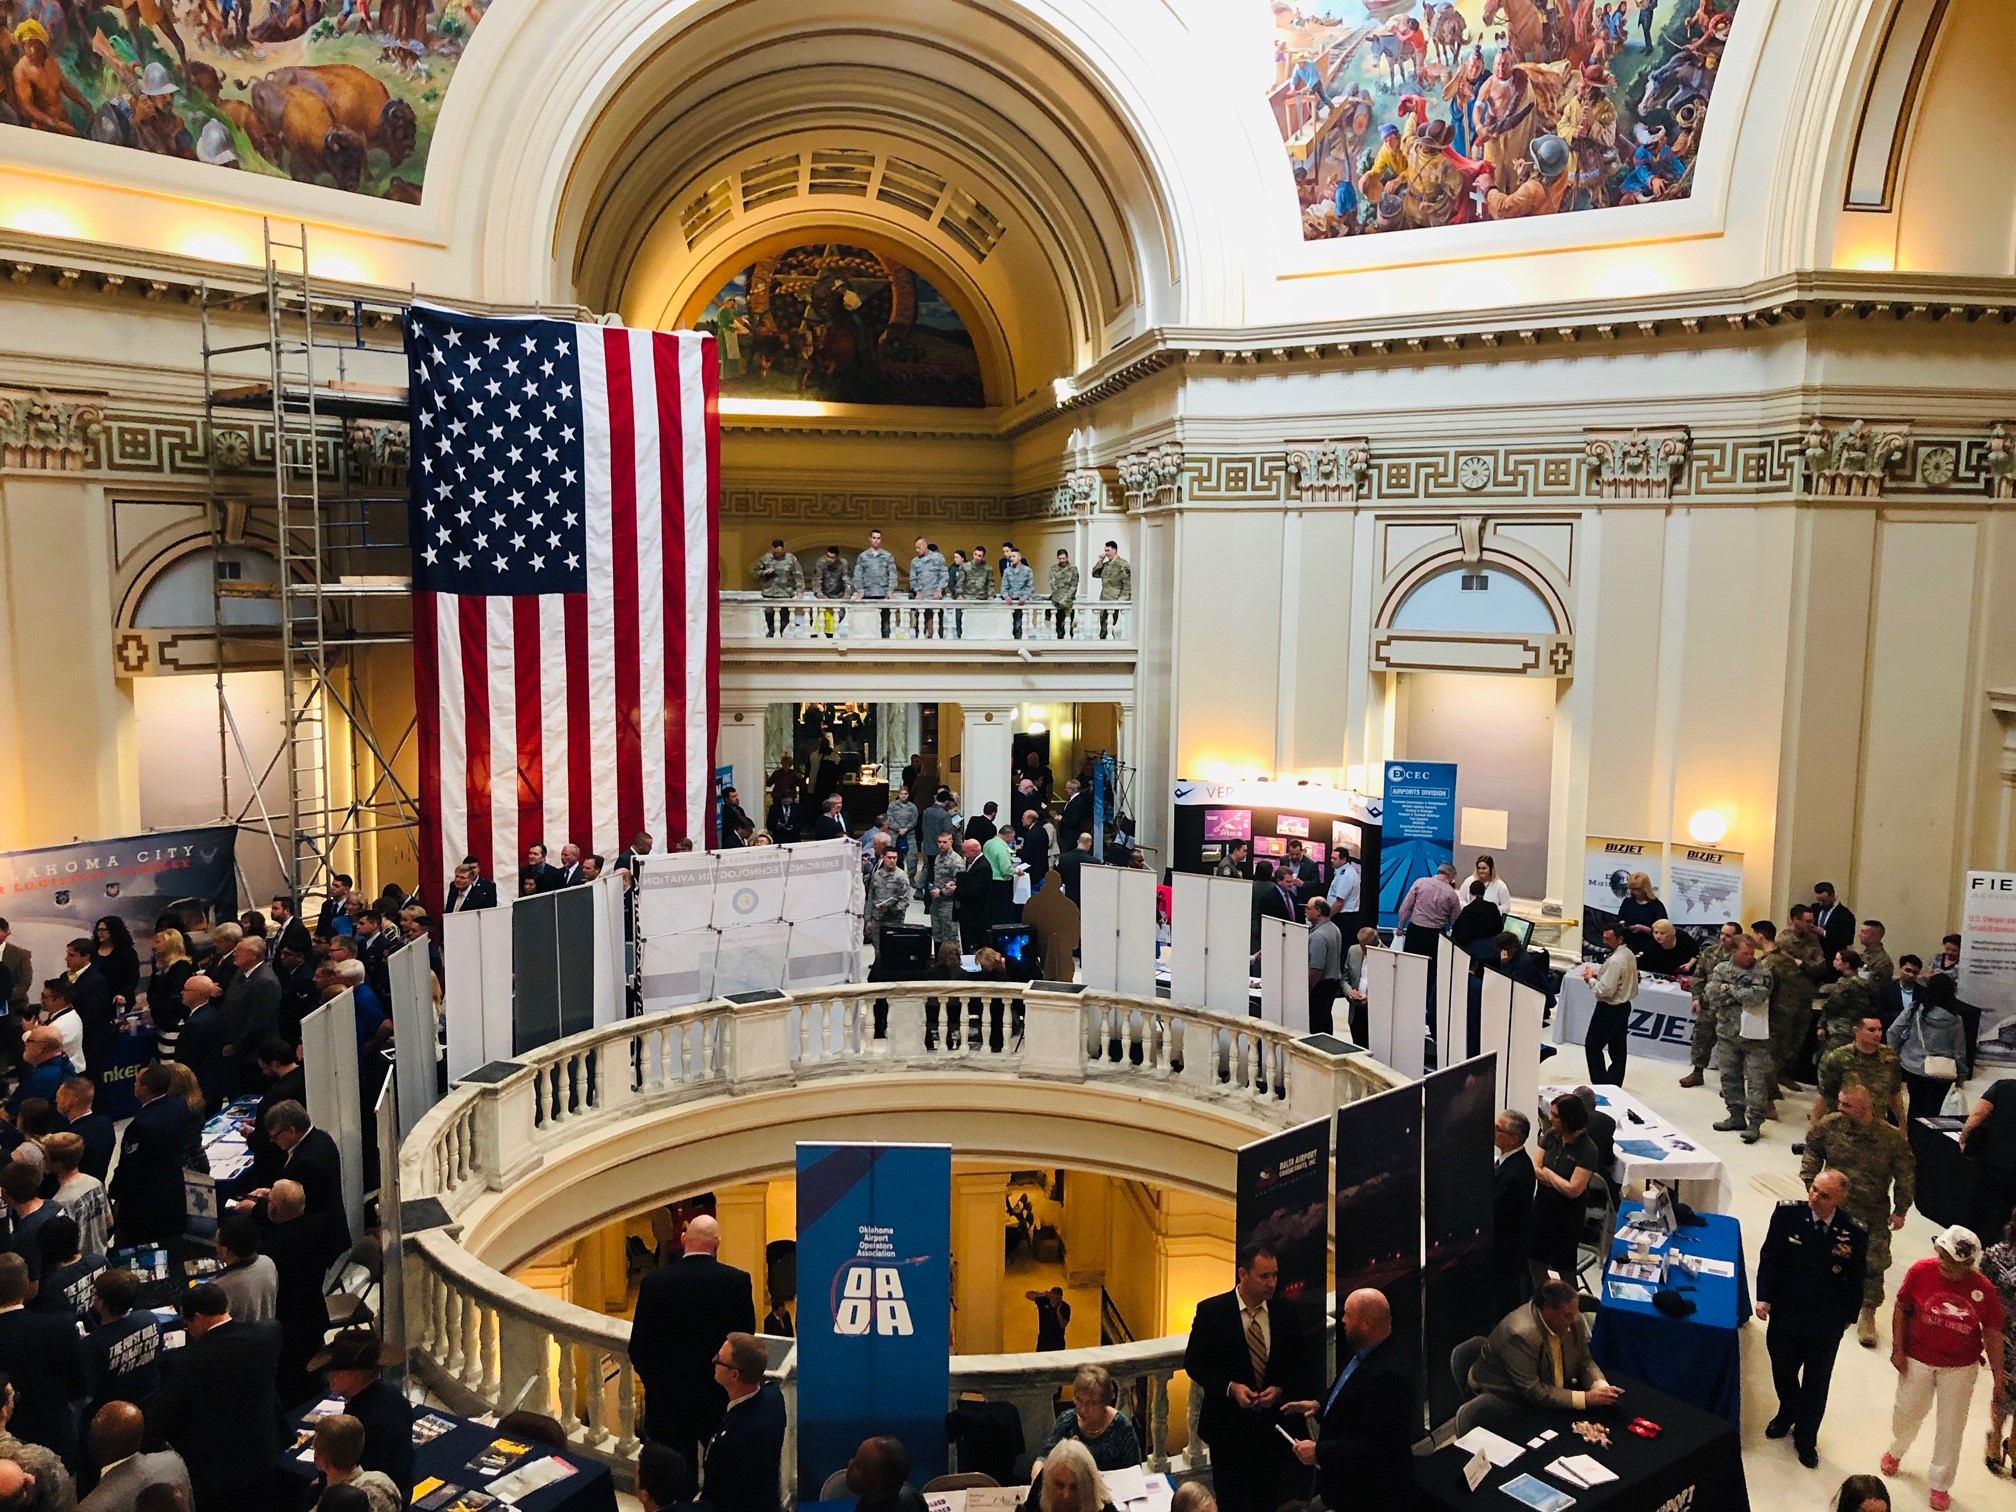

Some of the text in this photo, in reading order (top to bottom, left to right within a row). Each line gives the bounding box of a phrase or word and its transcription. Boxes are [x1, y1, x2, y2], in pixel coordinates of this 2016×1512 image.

[1392, 788, 1447, 797] AIRPORTS DIVISION
[136, 845, 194, 863] CITY
[1605, 843, 1645, 856] BIZJET
[1687, 850, 1725, 865] BIZJET
[1295, 1149, 1318, 1164] AIRPORT
[859, 1225, 894, 1235] Oklahoma
[863, 1233, 889, 1243] Airport
[859, 1241, 894, 1250] Operators
[856, 1249, 896, 1258] Association
